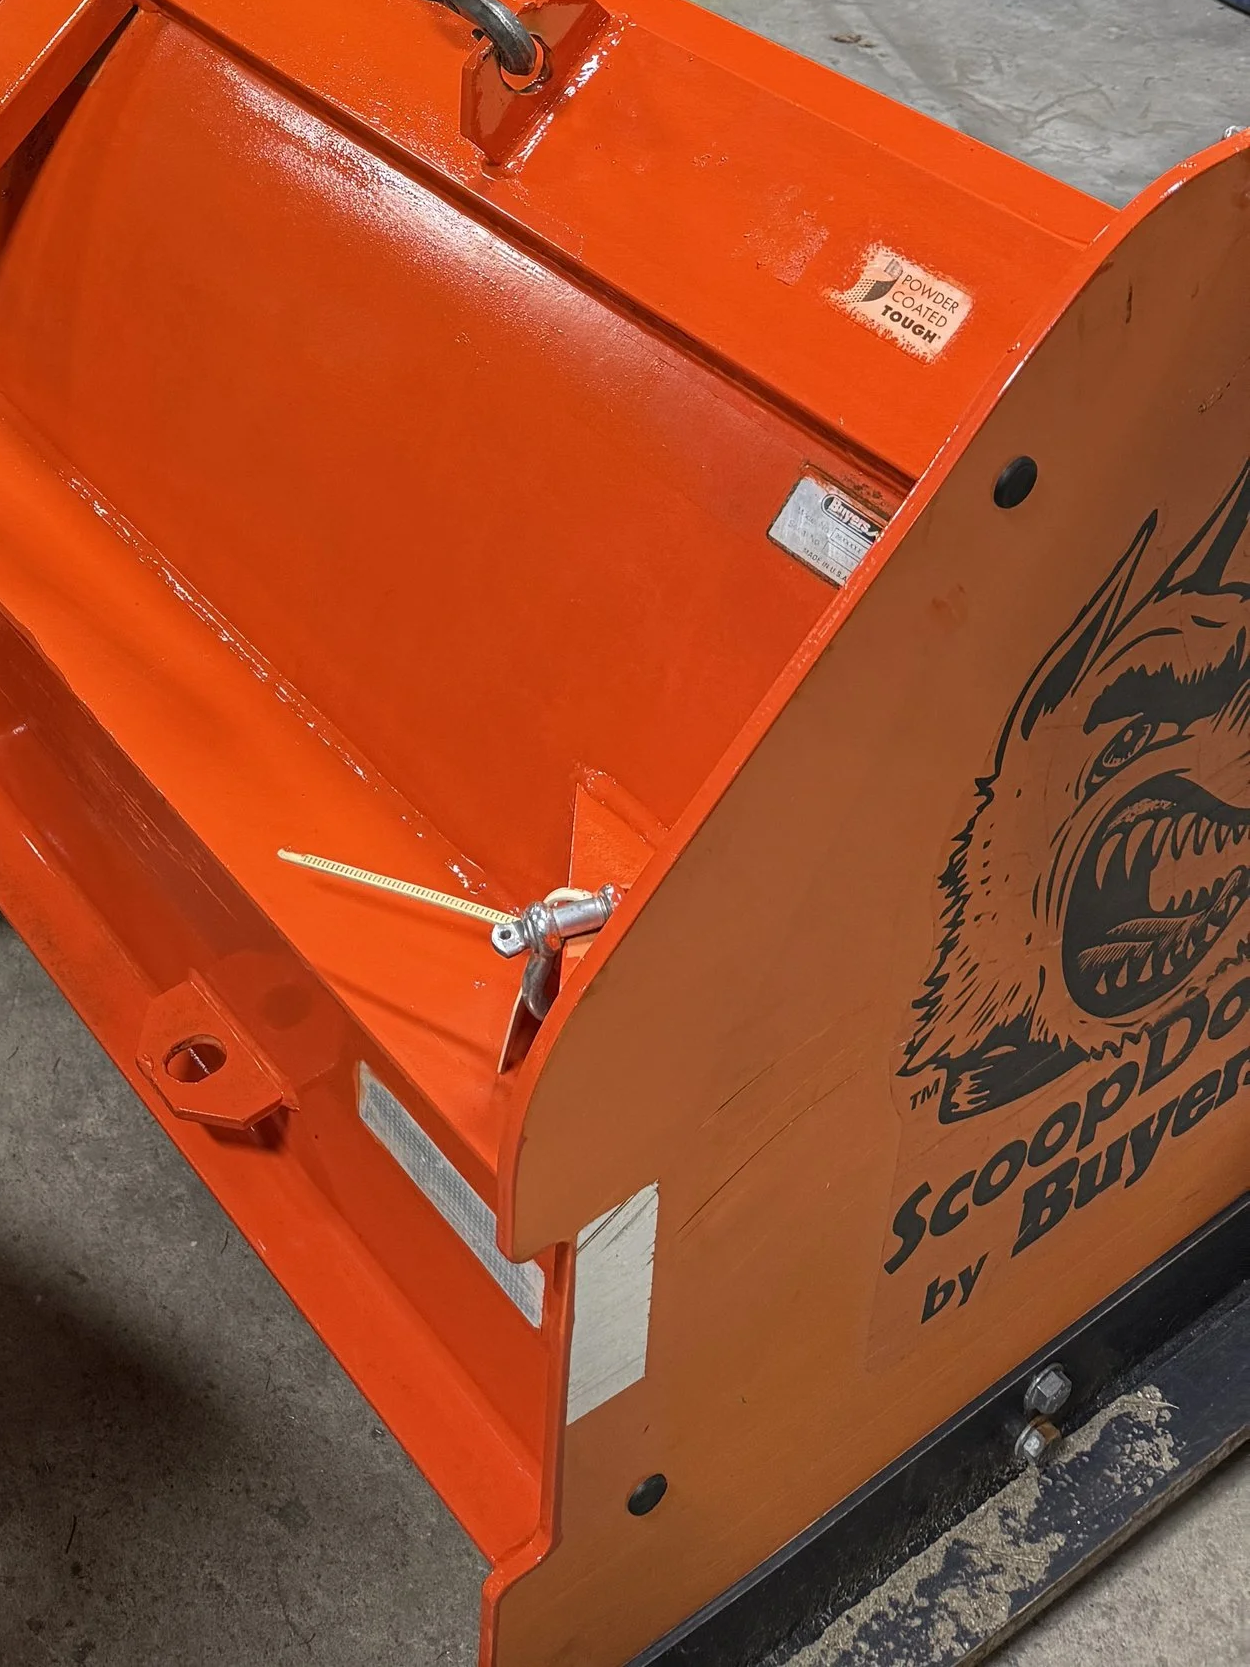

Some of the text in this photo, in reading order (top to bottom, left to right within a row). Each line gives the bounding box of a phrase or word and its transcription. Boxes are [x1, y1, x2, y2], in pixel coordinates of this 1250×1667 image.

[892, 291, 948, 328] COATED
[902, 274, 959, 314] POWDER
[827, 496, 872, 533] Buyers
[910, 1077, 940, 1110] TM
[921, 1045, 1250, 1324] by Buyer
